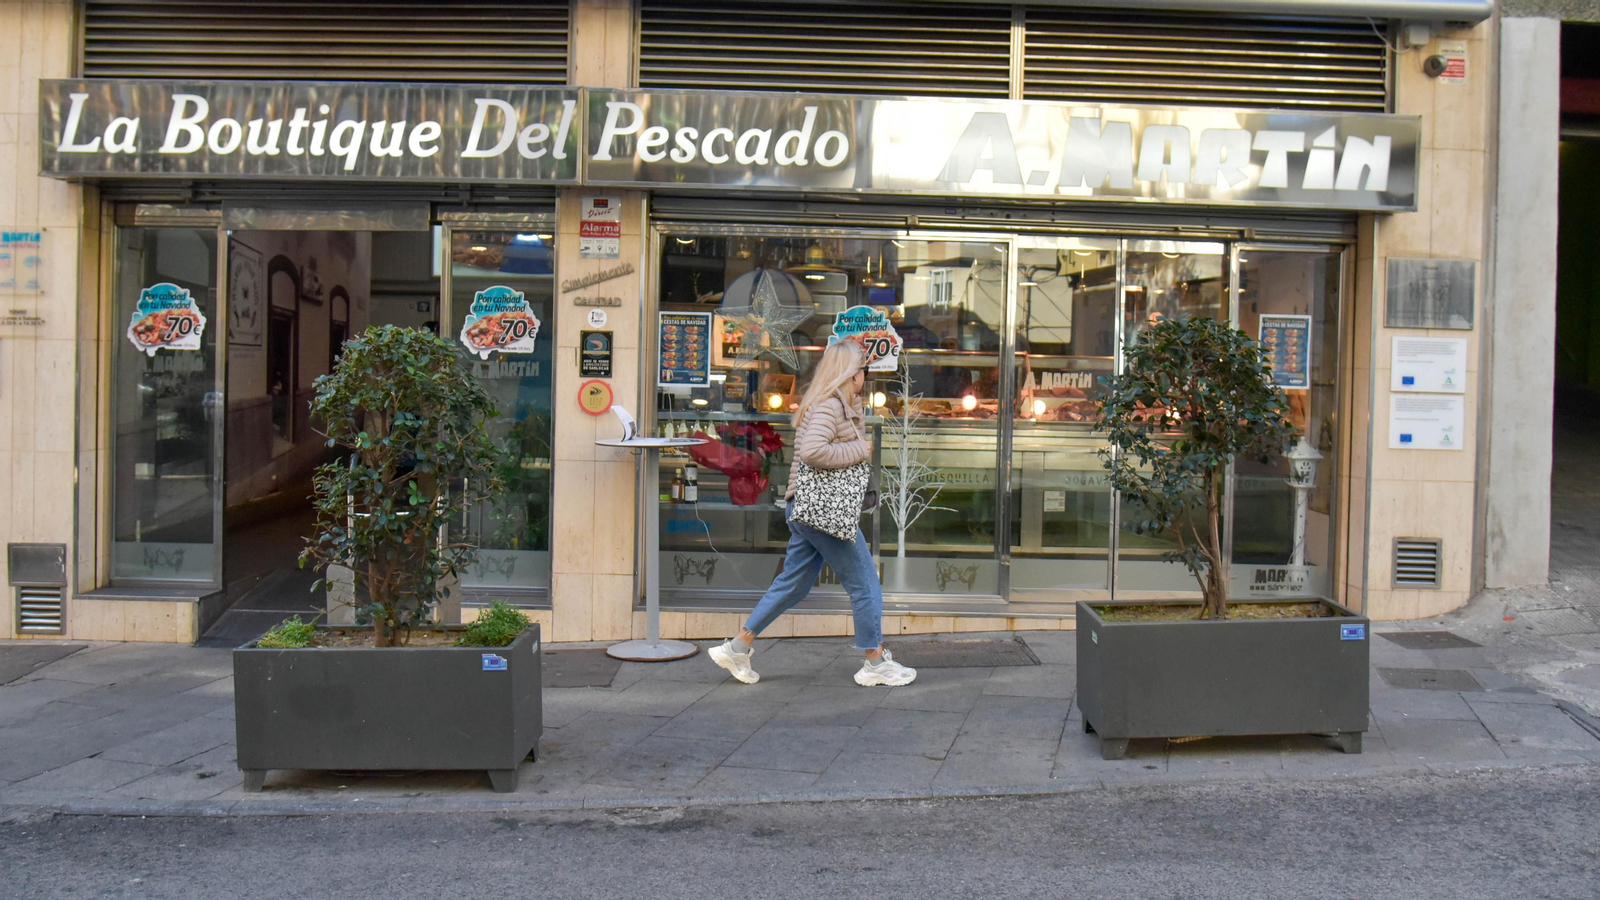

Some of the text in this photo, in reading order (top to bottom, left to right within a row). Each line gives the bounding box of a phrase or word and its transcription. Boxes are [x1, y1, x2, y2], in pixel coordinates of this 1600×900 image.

[57, 93, 849, 170] La Boutique Del Pescado
[588, 207, 614, 218] Direct
[582, 223, 619, 232] Alarma
[562, 262, 634, 292] Simplemente
[144, 291, 186, 300] Pon calidad
[477, 295, 521, 304] Pon calidad
[161, 301, 191, 309] Navidad
[573, 297, 621, 307] CALIDAD
[495, 304, 526, 312] Navidad
[839, 314, 882, 323] Pon calidad
[856, 323, 887, 332] Navidad
[918, 474, 989, 483] QUISQUILLA
[1254, 568, 1309, 583] MAR
